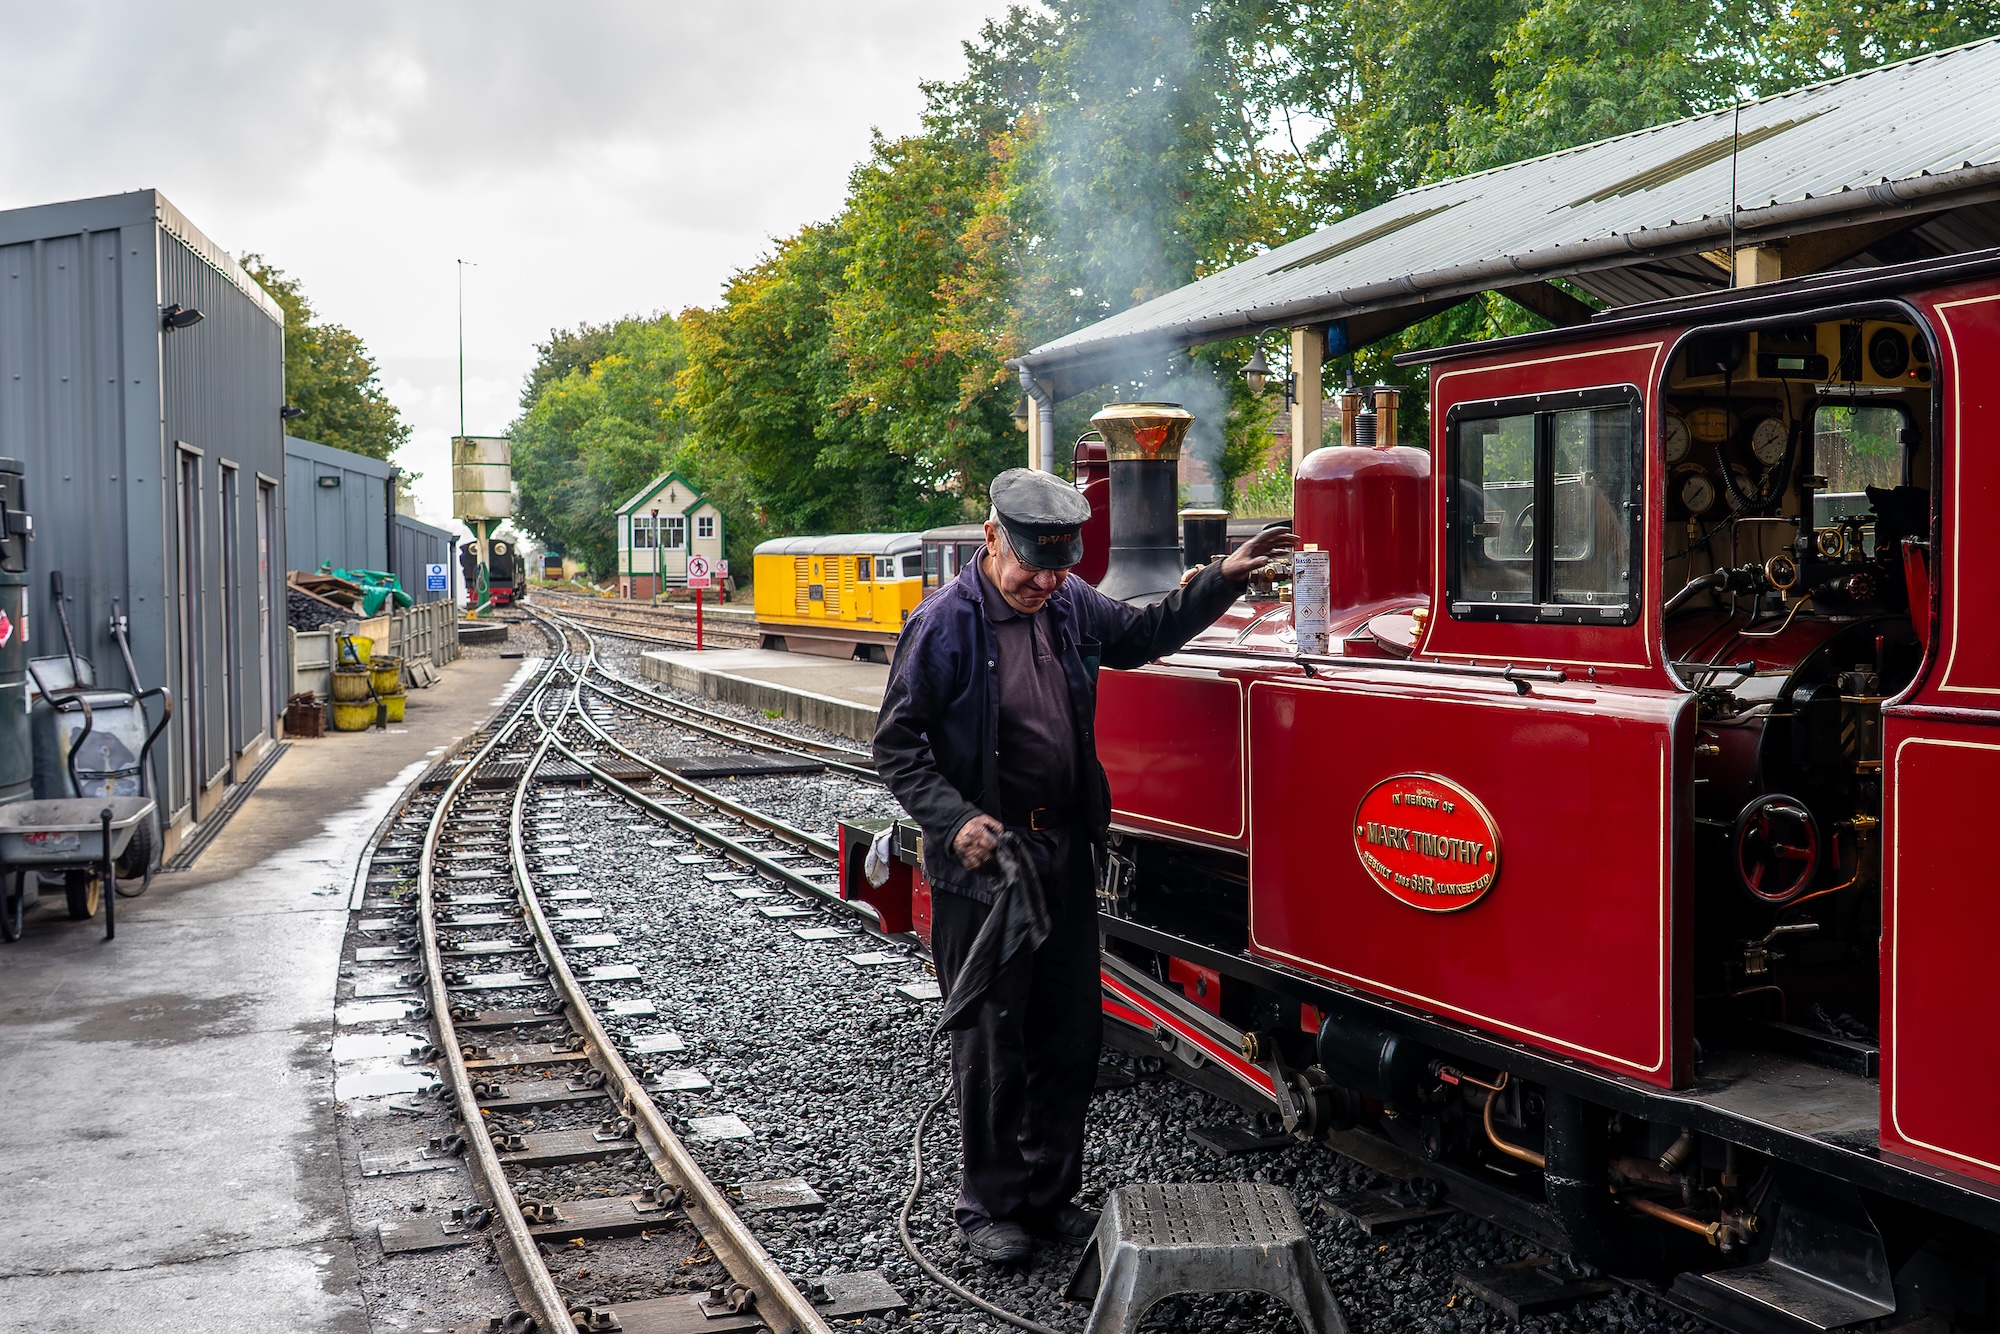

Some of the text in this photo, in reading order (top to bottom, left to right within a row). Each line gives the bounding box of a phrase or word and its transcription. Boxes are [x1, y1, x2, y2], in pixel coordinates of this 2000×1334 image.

[1392, 794, 1454, 813] IN MEMORY OF
[1367, 822, 1483, 865] MARK TIMOTHY
[1364, 851, 1392, 879] REBUILT
[1411, 874, 1435, 895] 69R
[1436, 882, 1456, 895] ALAN
[1456, 881, 1477, 895] KEEF
